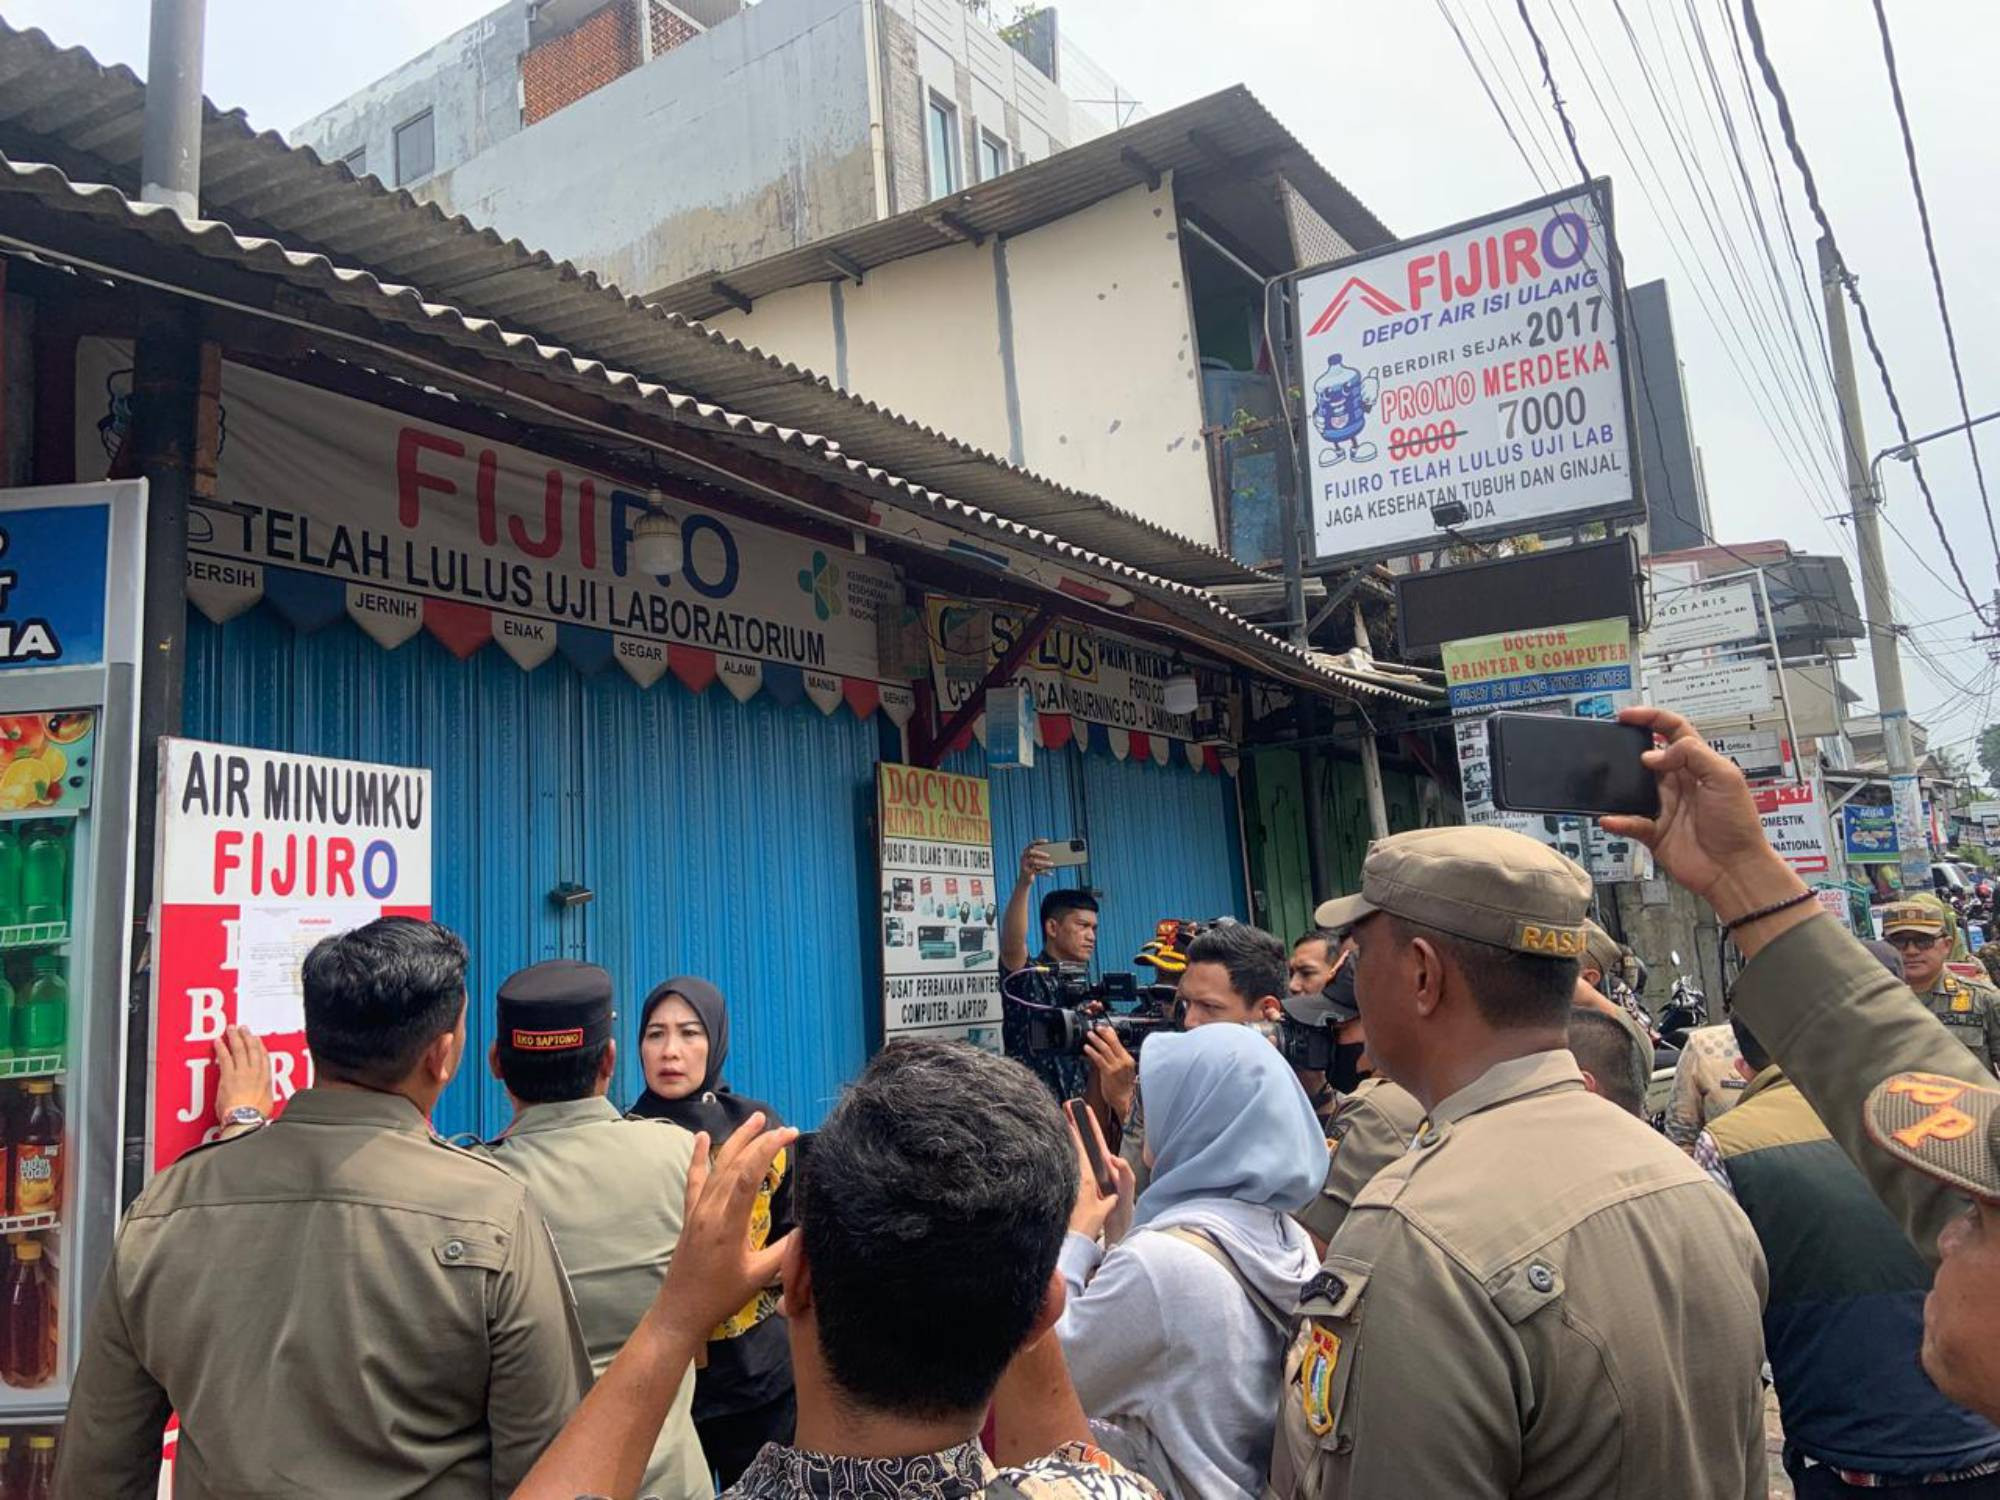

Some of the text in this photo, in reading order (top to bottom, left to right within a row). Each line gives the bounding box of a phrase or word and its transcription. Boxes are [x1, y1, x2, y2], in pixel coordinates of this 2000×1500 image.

[1407, 212, 1590, 311] FIJIRO
[1362, 269, 1600, 348] DEPOT AIR ISI ULANG
[1382, 295, 1604, 379] BERDIRI SEJAK 2017
[1381, 340, 1611, 424] PROMO MERDEKA
[1389, 386, 1587, 461] 8000 7000
[1324, 423, 1615, 501] FIJIRO TELAH LULUS UJI LAB
[1325, 452, 1622, 527] JAGA KESEHATAN TUBUH DAN GINJAL
[231, 501, 826, 667] TELAH LULUS UJI LABORATORIUM
[354, 592, 418, 619] JERNIH
[1658, 596, 1727, 618] NOTARIS
[503, 621, 544, 641] ENAK
[1503, 631, 1567, 653] DOCTOR
[619, 641, 663, 662] SEGAR
[1451, 655, 1519, 681] PRINTER
[1542, 643, 1628, 668] COMPUTER
[723, 660, 757, 679] ALAMI
[1509, 679, 1547, 696] ULANG
[1583, 670, 1628, 689] PRINTER
[808, 674, 837, 693] MANIS
[1152, 685, 1166, 705] CO
[1072, 687, 1121, 725] BURNING
[1121, 699, 1137, 725] CD
[182, 750, 423, 830] AIR MINUMKU
[887, 766, 983, 816] DOCTOR
[1760, 814, 1805, 827] OMESTIK
[1769, 839, 1822, 852] NATIONAL
[213, 830, 398, 900] FIJIRO
[885, 975, 1000, 999] PUSAT PERBAIKAN PRINTER
[901, 1001, 949, 1024] COMPUTER
[957, 999, 988, 1019] LAPTOP
[517, 1034, 578, 1046] EKO SAPTONO
